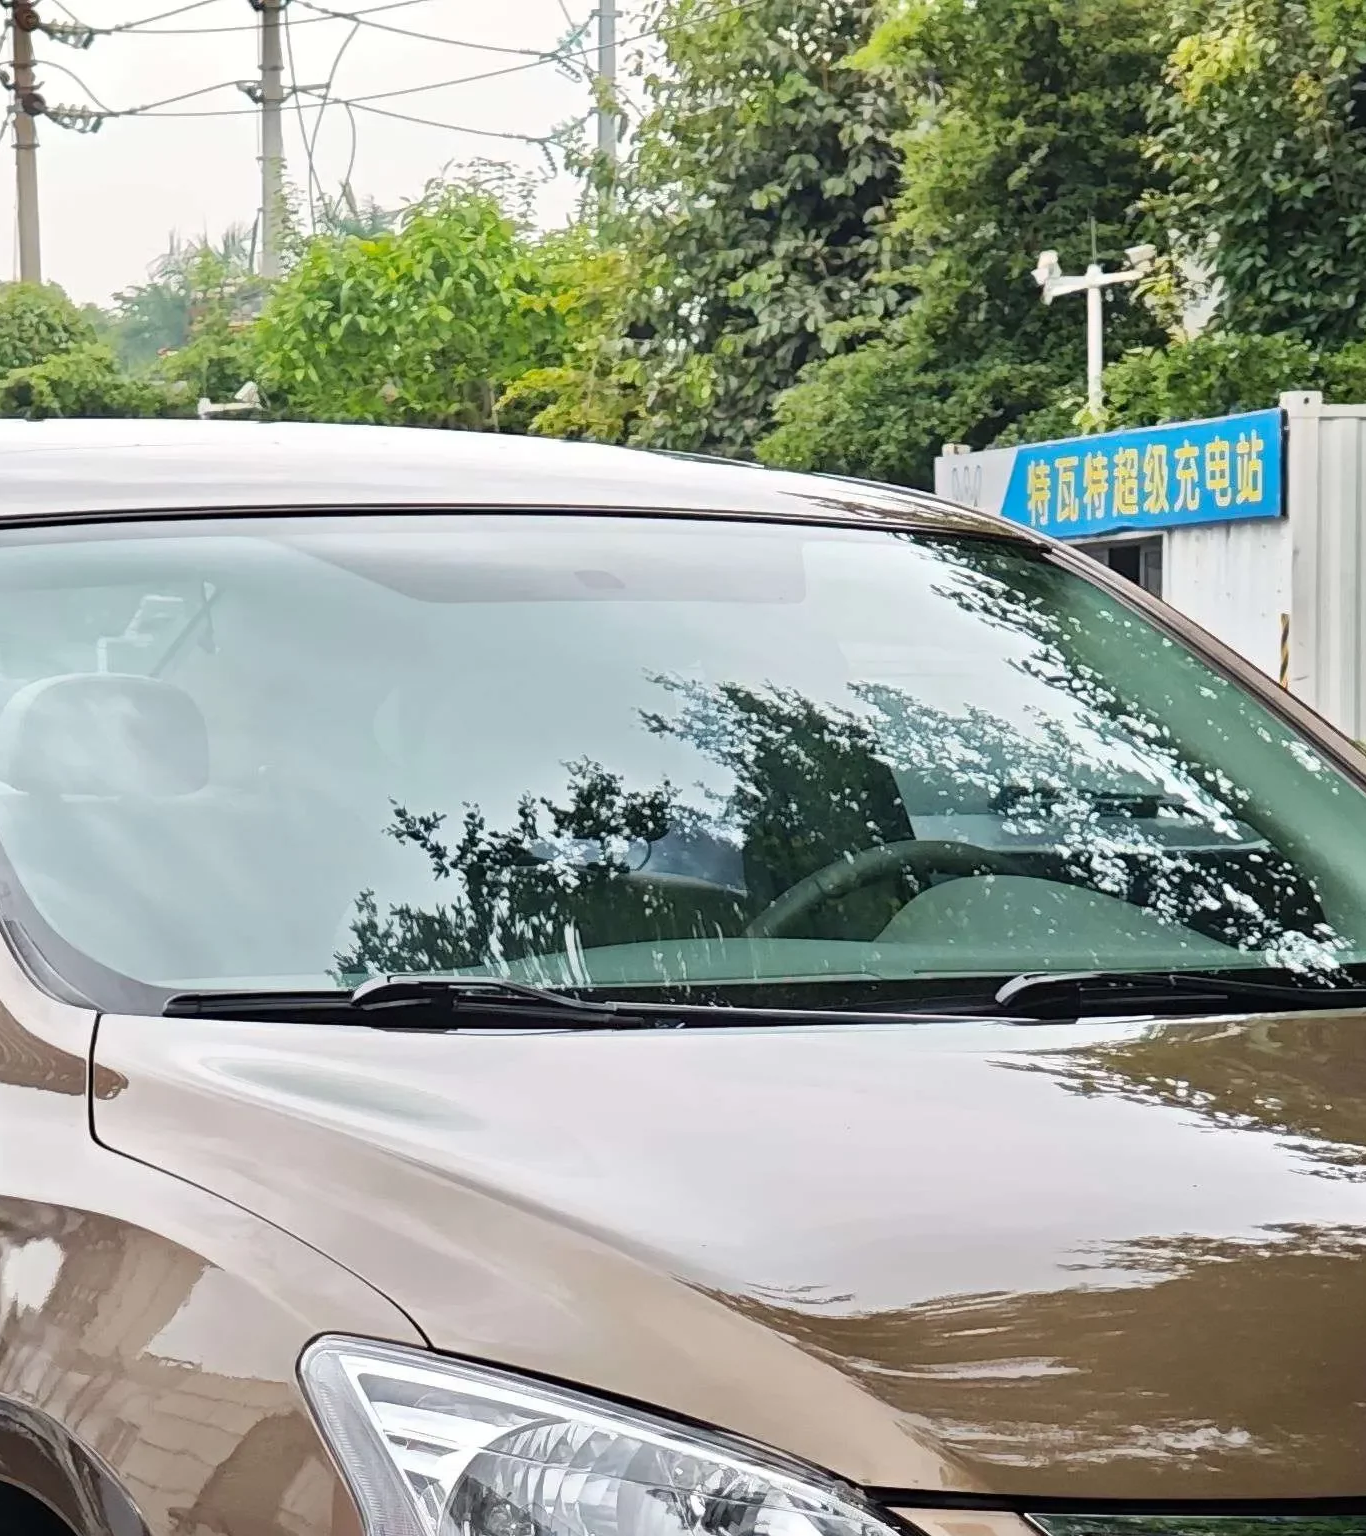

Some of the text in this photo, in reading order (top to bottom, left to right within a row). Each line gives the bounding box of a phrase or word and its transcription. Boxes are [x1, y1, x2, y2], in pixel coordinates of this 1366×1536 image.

[1026, 429, 1264, 526] 特瓦特超级充电站
